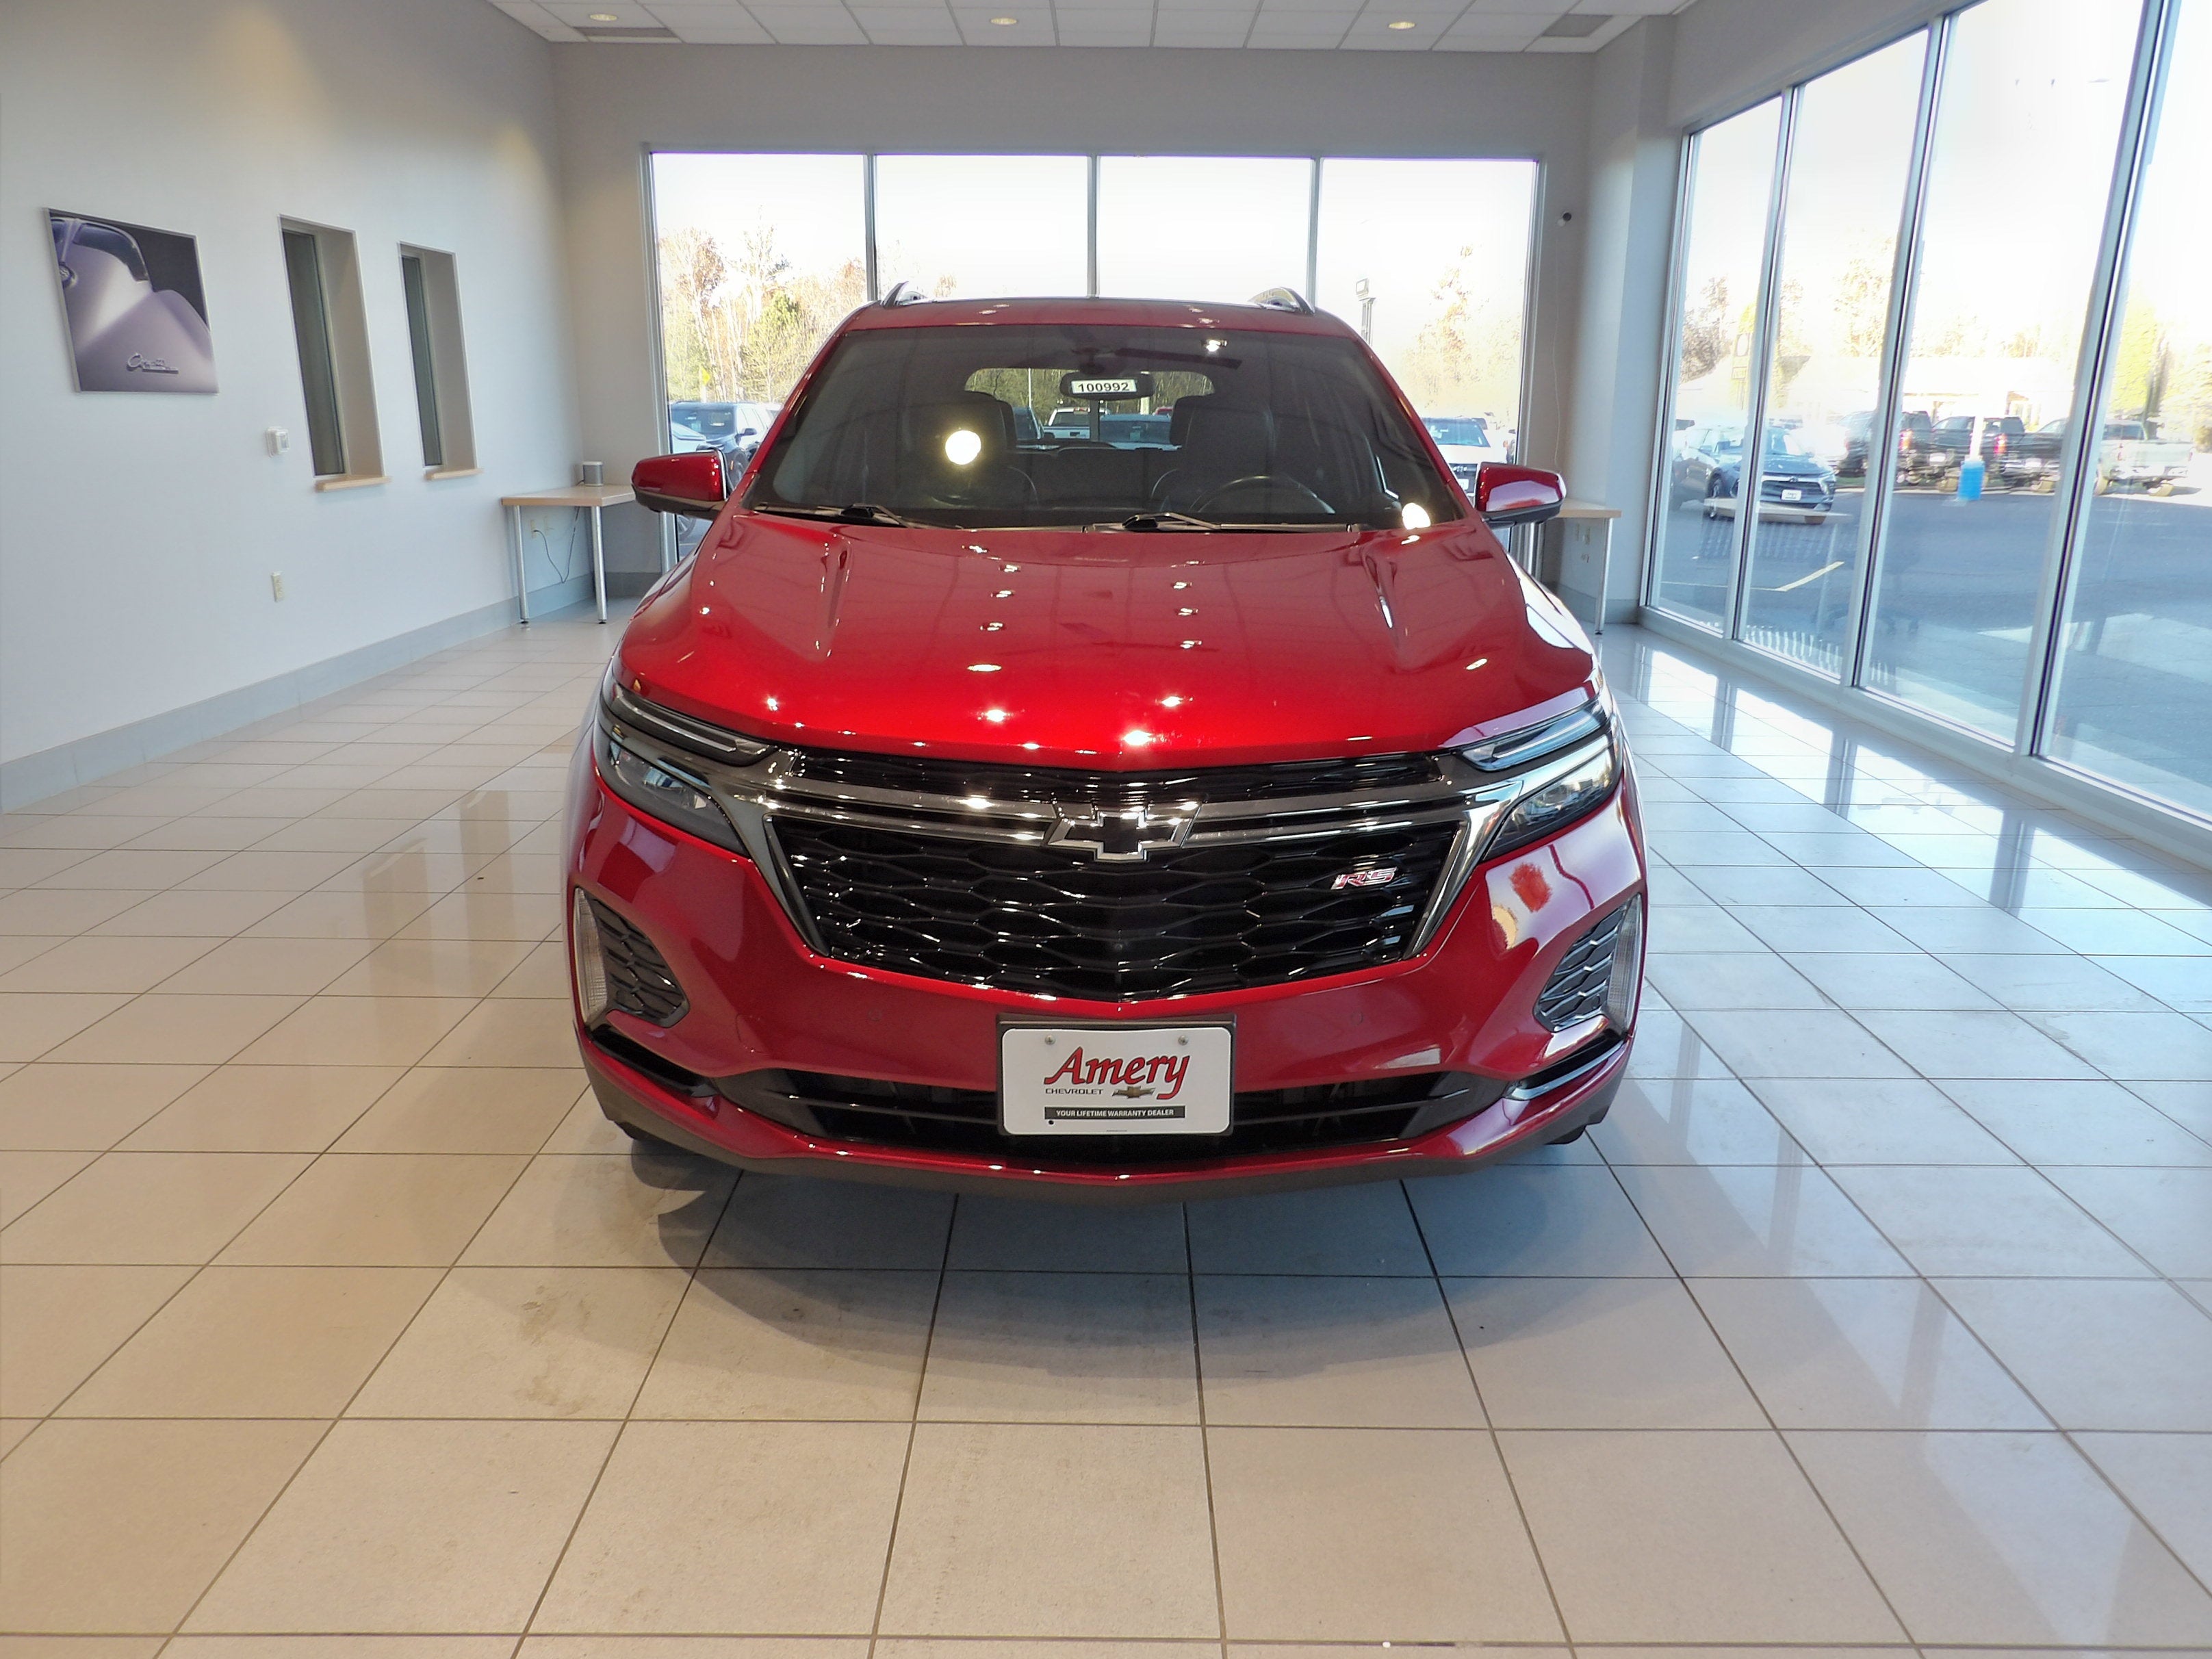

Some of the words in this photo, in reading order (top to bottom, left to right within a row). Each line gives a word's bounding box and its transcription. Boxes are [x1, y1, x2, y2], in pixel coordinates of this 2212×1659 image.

[1078, 382, 1129, 392] 100992
[1330, 866, 1398, 890] RS
[1044, 1046, 1190, 1099] Amery
[1107, 1109, 1146, 1117] WARRANTY
